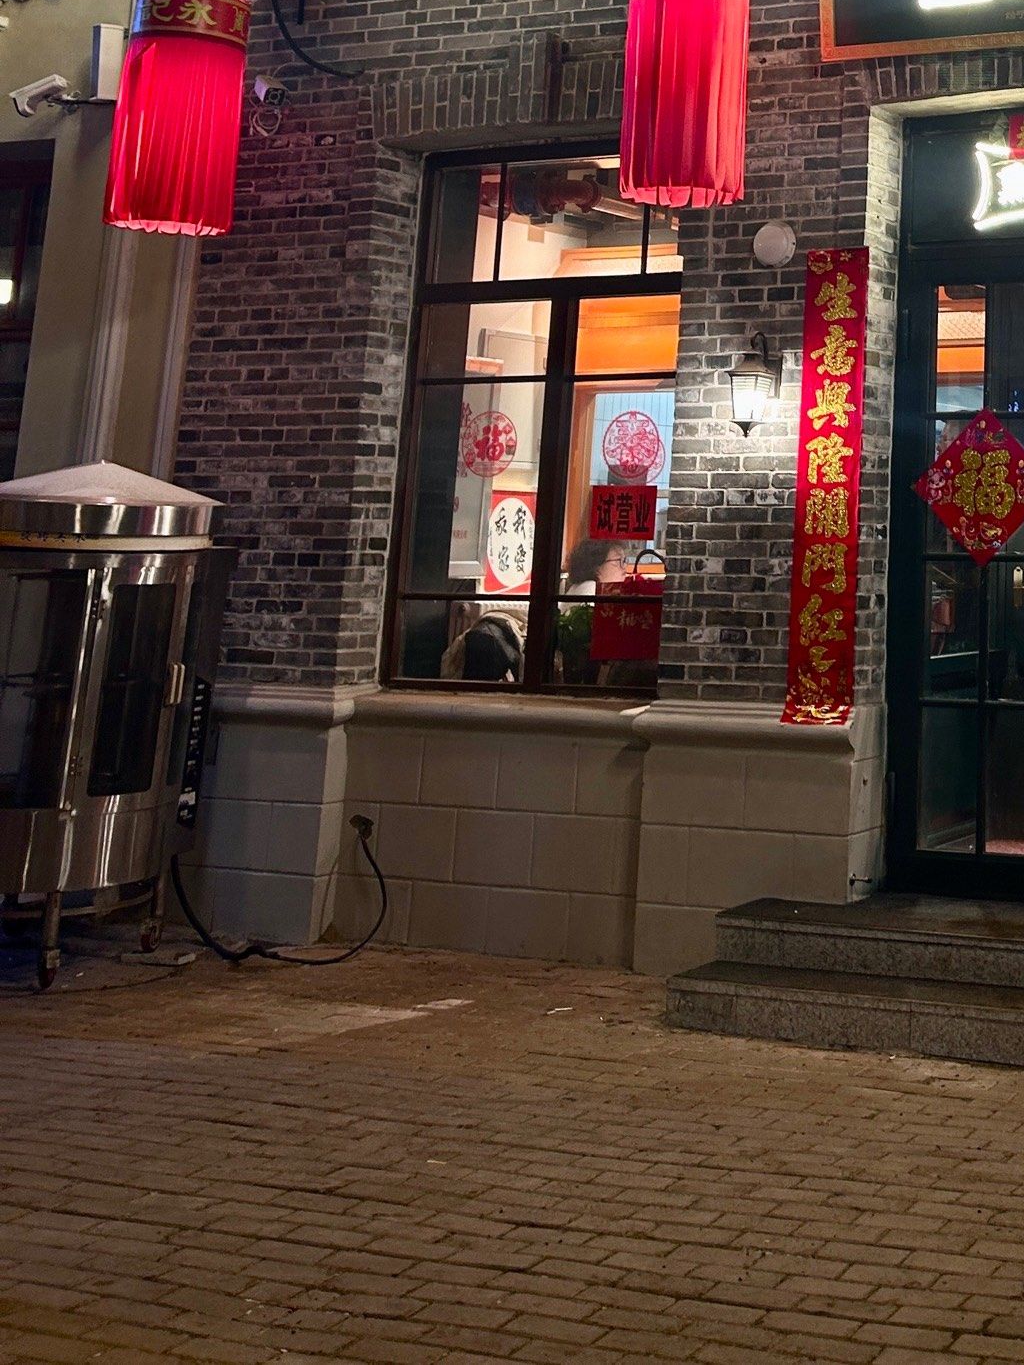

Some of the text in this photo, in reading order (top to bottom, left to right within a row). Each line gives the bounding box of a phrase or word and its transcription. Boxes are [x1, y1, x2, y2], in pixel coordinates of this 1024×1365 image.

[952, 447, 1016, 519] 福
[597, 492, 651, 533] 试营业
